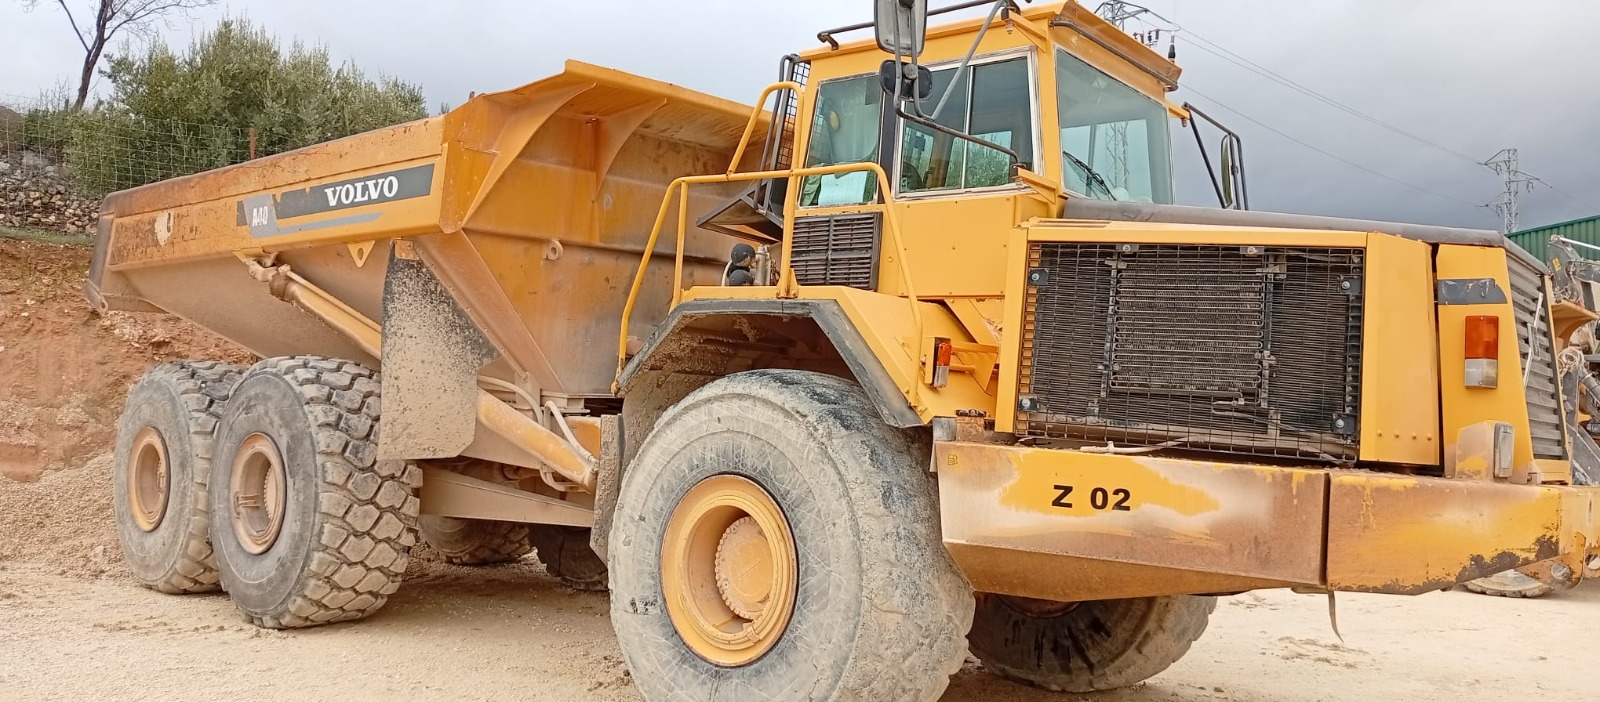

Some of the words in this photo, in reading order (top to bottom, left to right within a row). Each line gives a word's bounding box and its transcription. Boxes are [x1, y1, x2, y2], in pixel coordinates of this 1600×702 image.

[324, 175, 399, 207] VOLVO
[252, 206, 268, 226] A40
[1051, 484, 1073, 508] Z
[1090, 487, 1130, 511] 02
